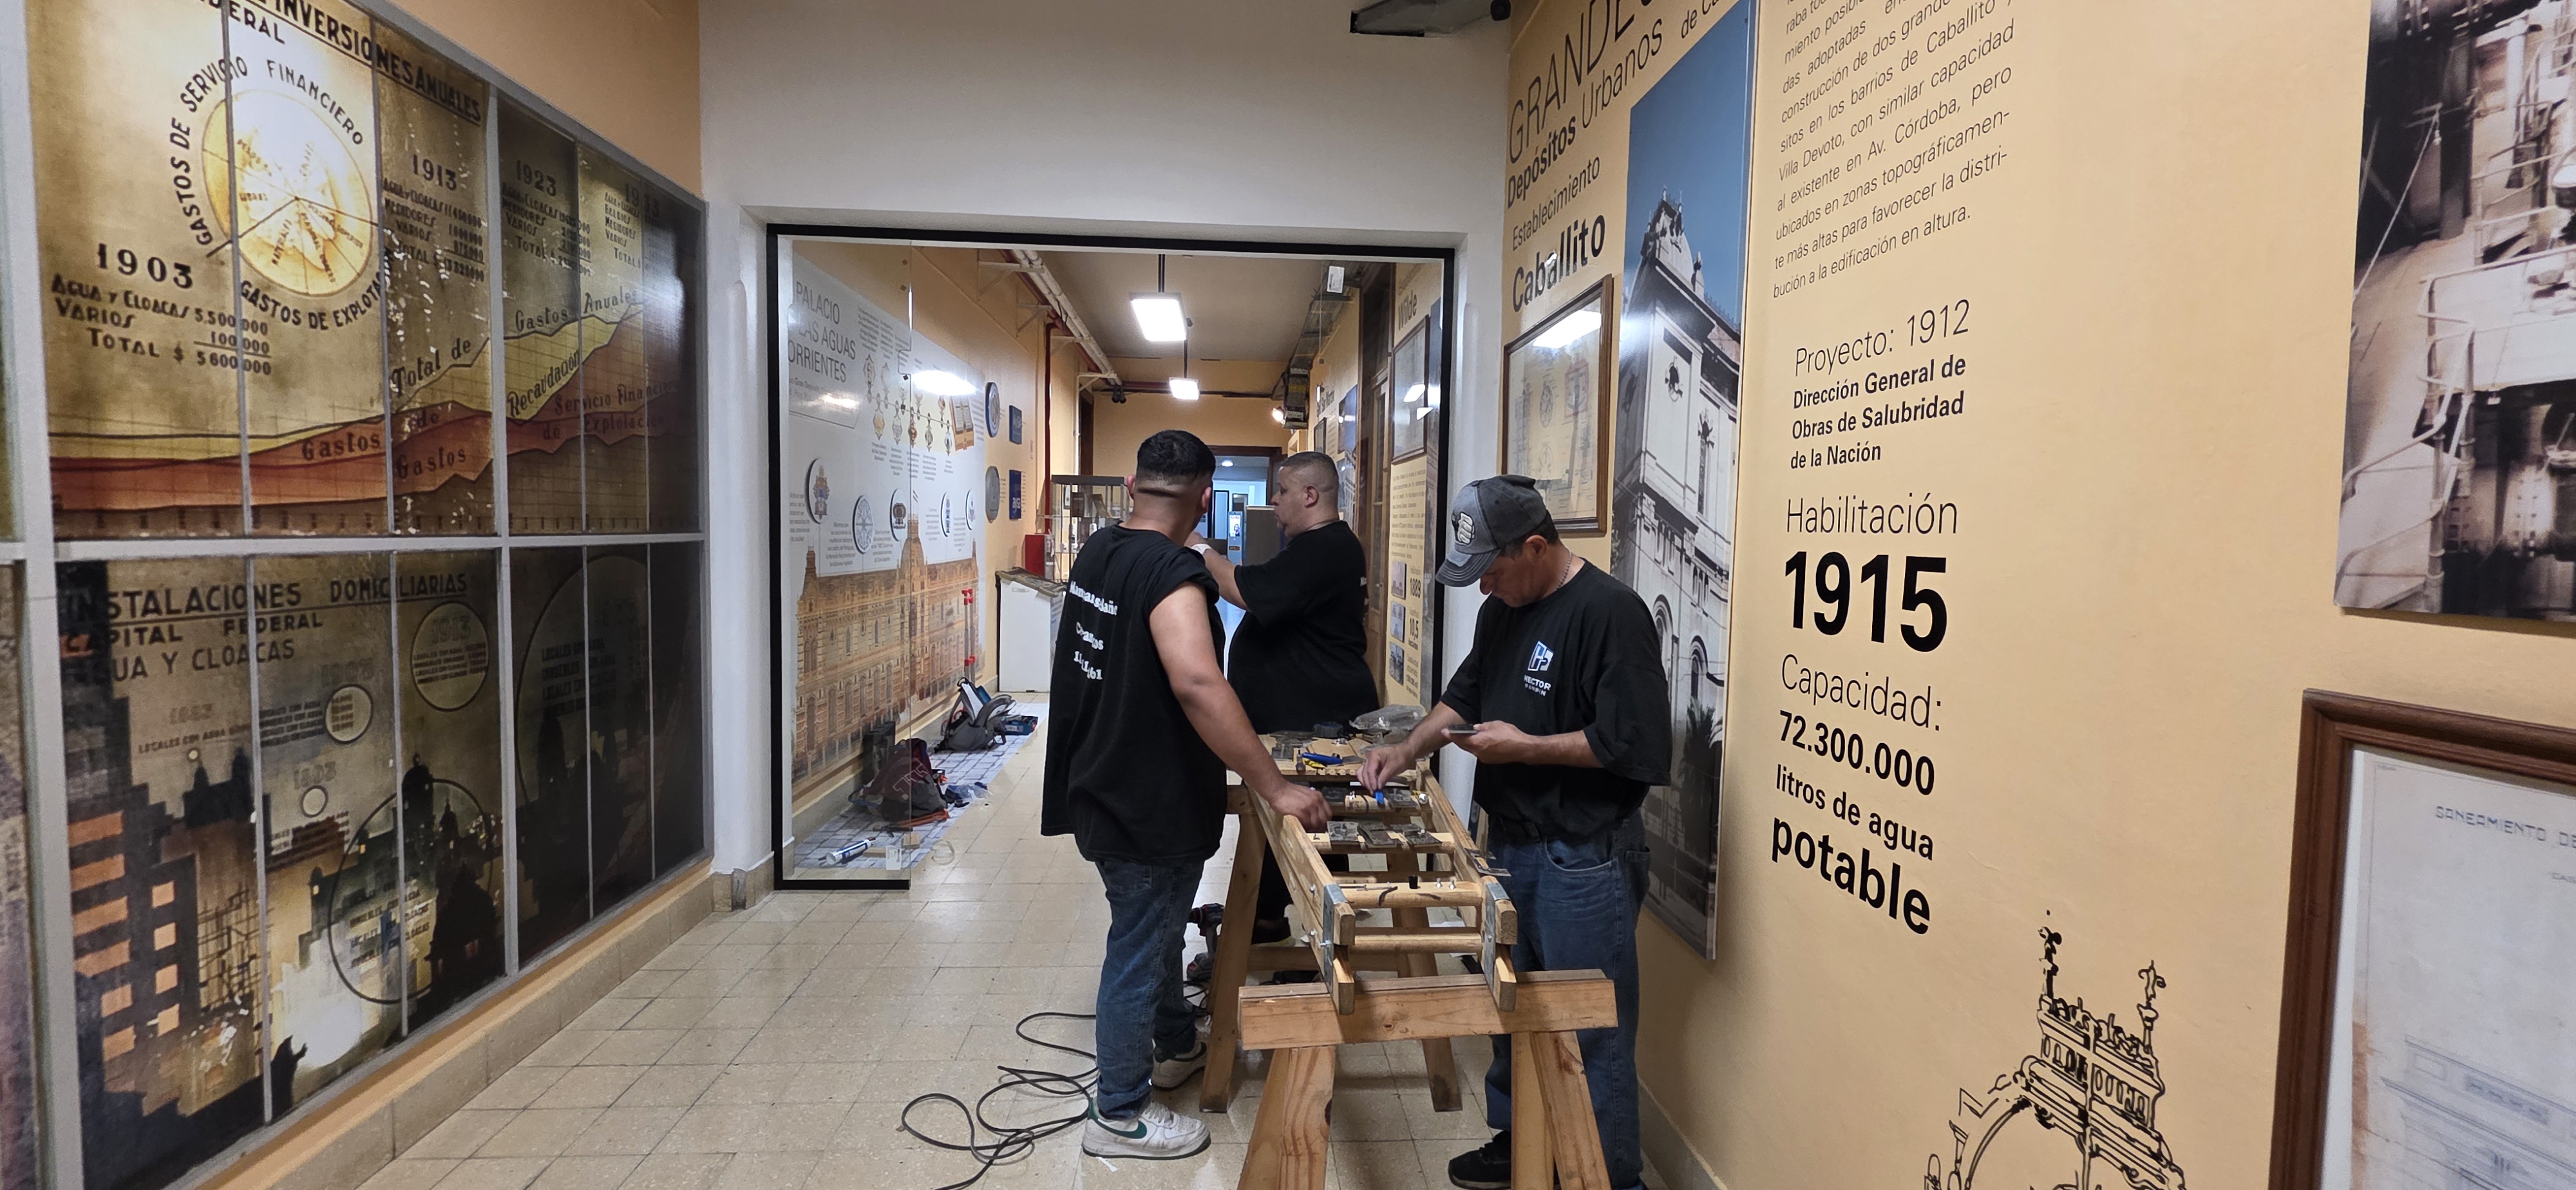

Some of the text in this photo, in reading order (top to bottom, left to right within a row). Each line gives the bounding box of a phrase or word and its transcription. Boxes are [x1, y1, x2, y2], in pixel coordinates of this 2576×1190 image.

[1784, 26, 1821, 64] miento
[1786, 8, 1807, 35] raba
[1508, 0, 1653, 164] GRANDE
[1780, 128, 1804, 153] sitos
[1808, 116, 1823, 134] en
[1828, 104, 1844, 122] los
[1850, 66, 1893, 105] barrios
[1900, 50, 1918, 72] de
[1926, 0, 1996, 53] Caballito
[1781, 64, 1849, 124] construcción
[1852, 51, 1868, 71] de
[1872, 30, 1897, 58] dos
[1782, 19, 1866, 94] das adoptadas
[267, 59, 363, 145] FINANCIERO
[415, 60, 482, 122] ANUALES
[1508, 10, 1698, 209] Depósitos Urbanos de
[1779, 18, 2014, 182] Villa Devoto, con similar capacidad
[169, 117, 191, 149] DE
[1777, 67, 2012, 212] al existente en Av. Córdoba, pero
[170, 156, 213, 245] GASTOS
[413, 154, 457, 191] 1913
[516, 160, 557, 196] 1923
[1776, 112, 2011, 241] ubicados en zonas topográficamen-
[1512, 156, 1600, 252] Establecimiento
[1774, 145, 2008, 270] te más altas para favorecer la distri-
[97, 243, 193, 289] 1903
[1512, 214, 1605, 312] Caballito
[1773, 205, 1971, 299] bución a la edificación en altura.
[51, 272, 102, 302] AGUA
[124, 290, 190, 319] CLOACAS
[55, 296, 135, 329] VARIOS
[240, 280, 302, 326] GASTOS
[308, 312, 329, 330] DE
[796, 281, 840, 325] PALACIO
[86, 327, 160, 359] TOTAL
[390, 286, 637, 397] Total de Gastos Anuales
[788, 339, 847, 383] ORRIENTES
[821, 326, 856, 361] AGUAS
[1795, 299, 1970, 377] Proyecto: 1912
[1794, 354, 1967, 410] Dirección General de
[1792, 390, 1965, 440] Obras de Salubridad
[302, 433, 381, 461] Gastos
[397, 445, 466, 479] Gastos
[1790, 440, 1882, 469] de la Nación
[1786, 492, 1958, 534] Habilitación
[223, 612, 323, 636] FEDERAL
[1785, 551, 1948, 653] 1915
[161, 651, 179, 674] Y
[193, 638, 295, 672] CLOACAS
[1524, 674, 1551, 691] HECTOR
[1782, 654, 1942, 732] Capacidad:
[1779, 710, 1935, 796] 72.300.000
[1776, 764, 1933, 861] litros de agua
[2435, 805, 2547, 842] SANEAMIENTO
[1772, 817, 1931, 936] potable
